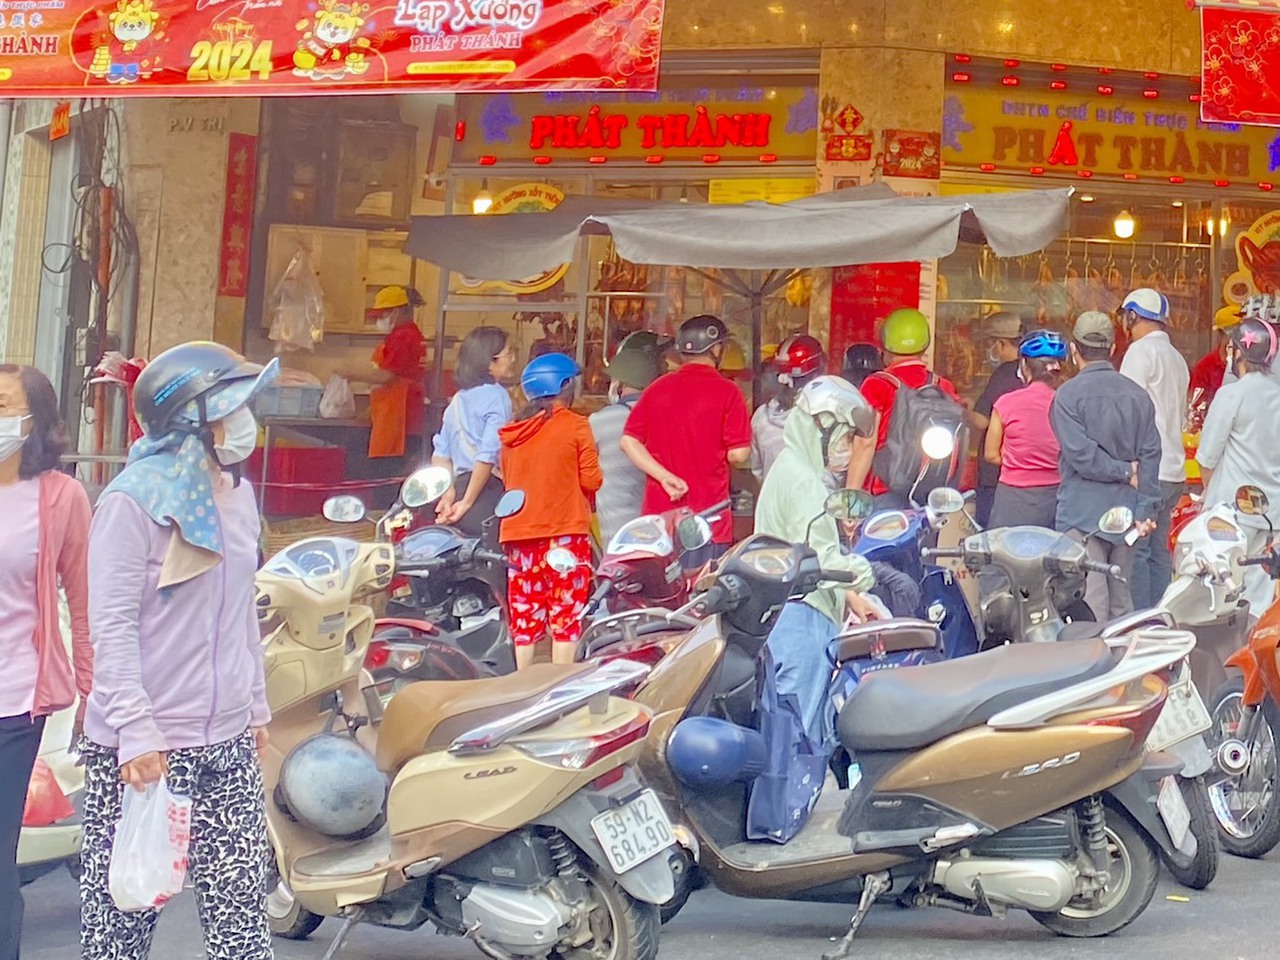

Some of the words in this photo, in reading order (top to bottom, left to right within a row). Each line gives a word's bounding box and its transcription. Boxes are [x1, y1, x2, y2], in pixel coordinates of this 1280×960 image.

[187, 40, 273, 81] 2024
[530, 105, 628, 149] PHÁT
[637, 105, 771, 149] THÀNH
[992, 121, 1103, 167] PHÁT
[1113, 131, 1250, 177] THÀNH
[610, 821, 671, 868] 684.90
